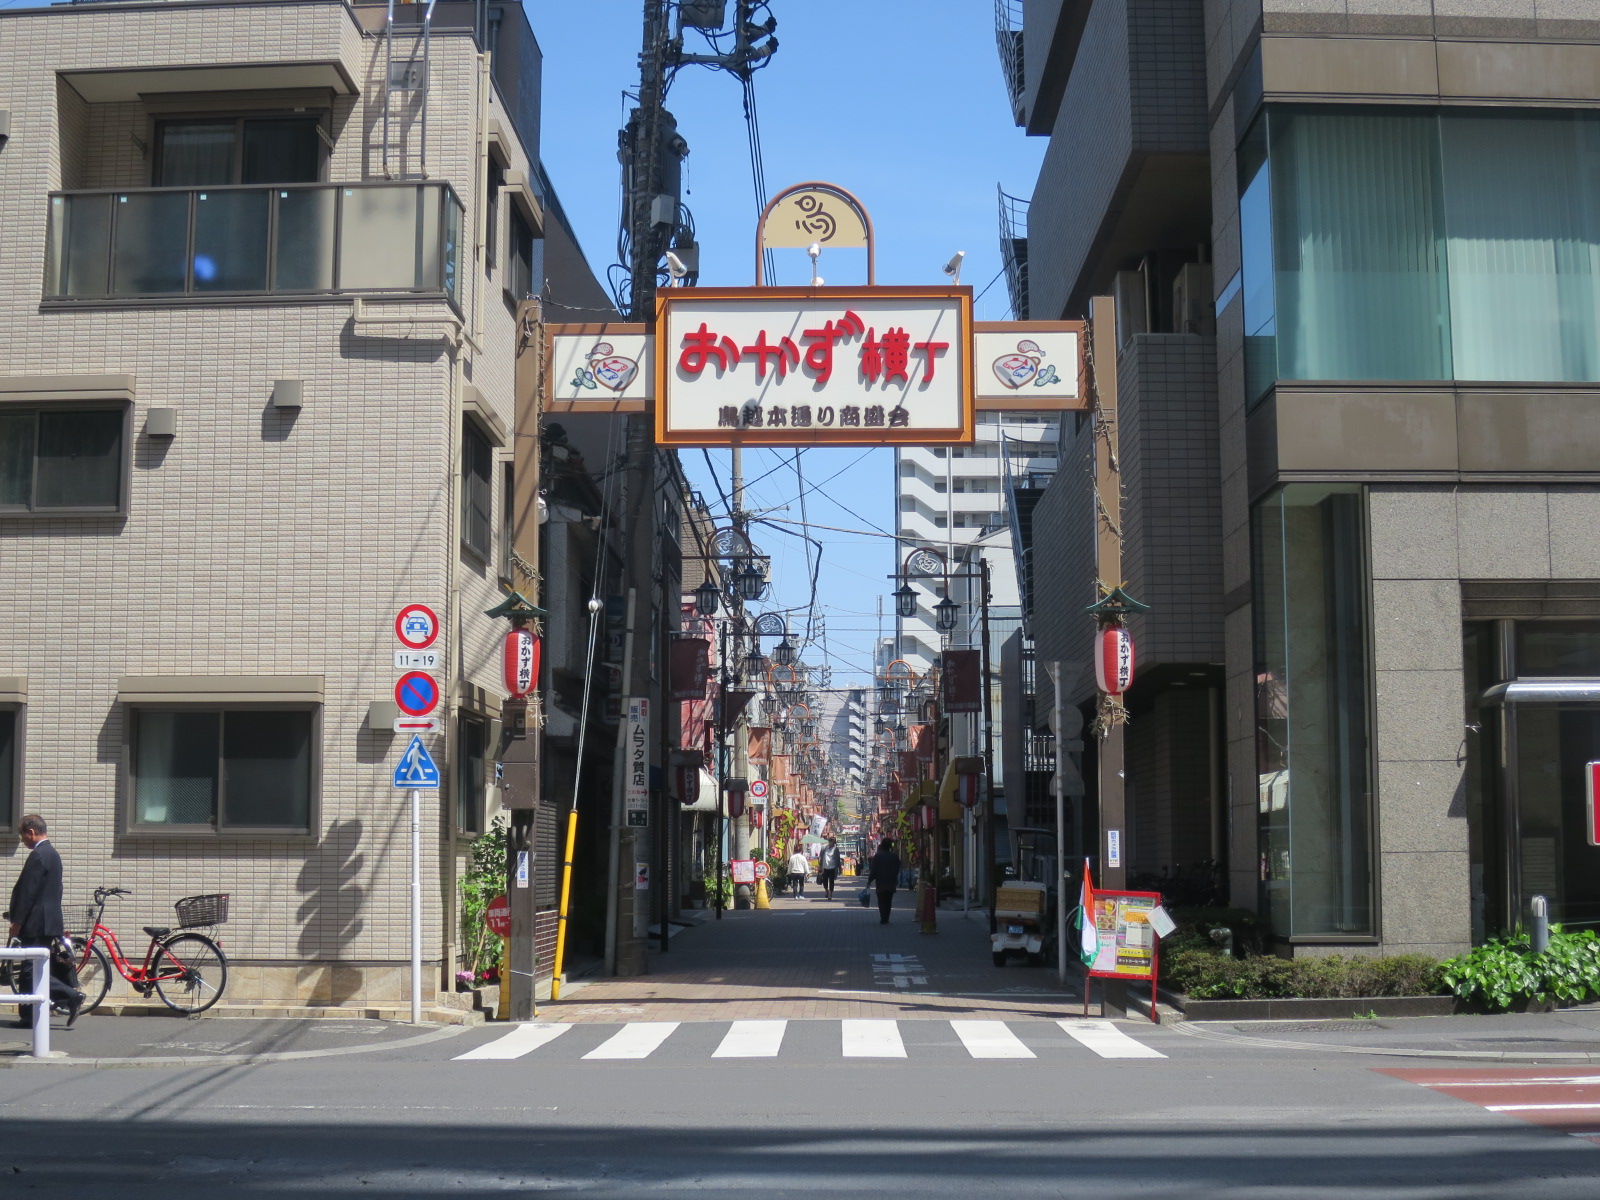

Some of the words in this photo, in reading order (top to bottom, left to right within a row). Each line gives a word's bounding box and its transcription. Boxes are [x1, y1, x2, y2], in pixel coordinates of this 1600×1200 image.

[680, 311, 949, 383] おかず横丁
[718, 405, 910, 427] 鳥越本通り商盛会
[519, 636, 531, 689] おかず横丁
[1119, 632, 1129, 687] おかず横丁
[632, 724, 645, 786] ムラタ質店
